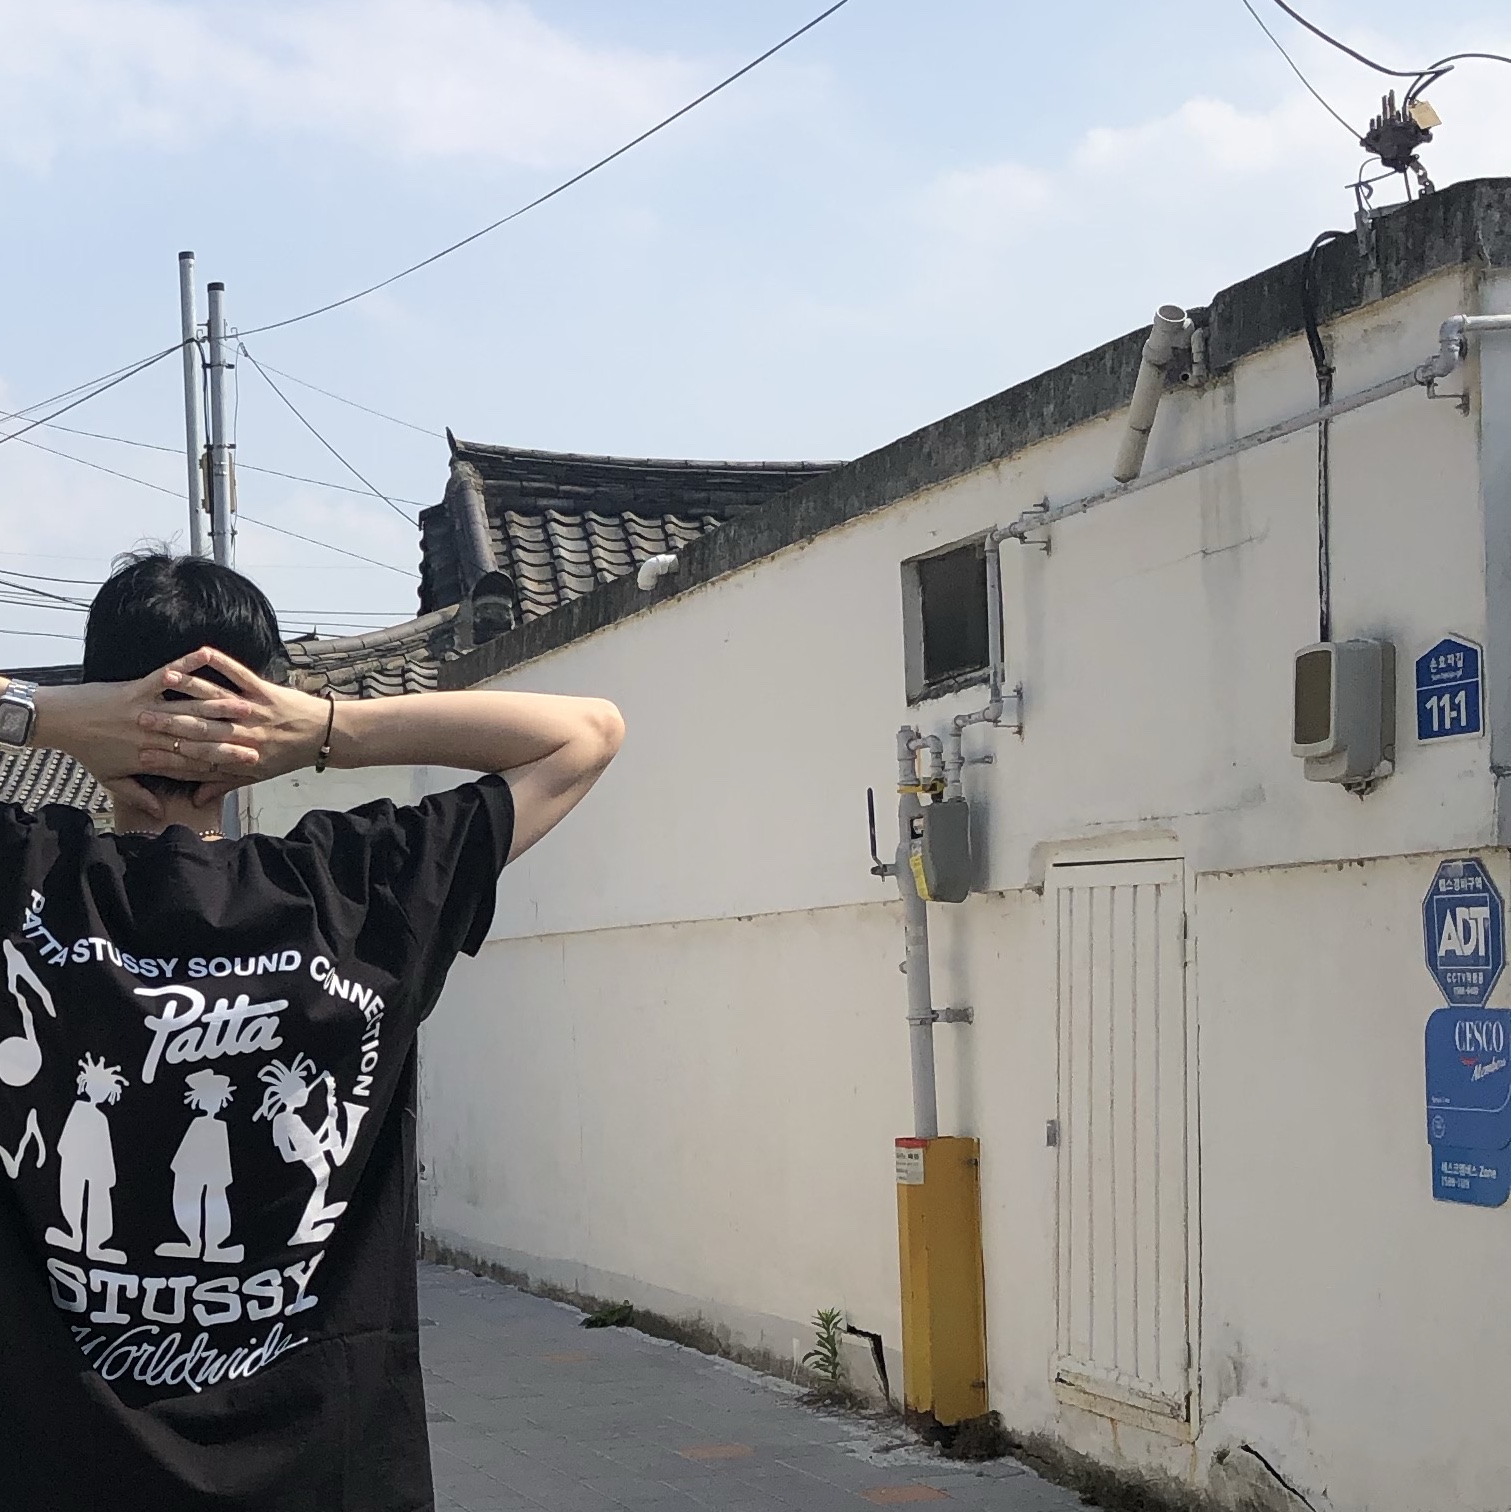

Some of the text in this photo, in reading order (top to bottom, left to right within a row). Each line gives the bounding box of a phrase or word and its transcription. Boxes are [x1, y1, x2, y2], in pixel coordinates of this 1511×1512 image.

[1424, 690, 1467, 732] 11-1
[1438, 907, 1490, 957] ADT
[22, 888, 385, 1097] PATTA STUSSY SOUND CONNECTION
[133, 985, 289, 1084] Patta
[1455, 1020, 1504, 1053] CESCO
[46, 1249, 326, 1327] STUSSY
